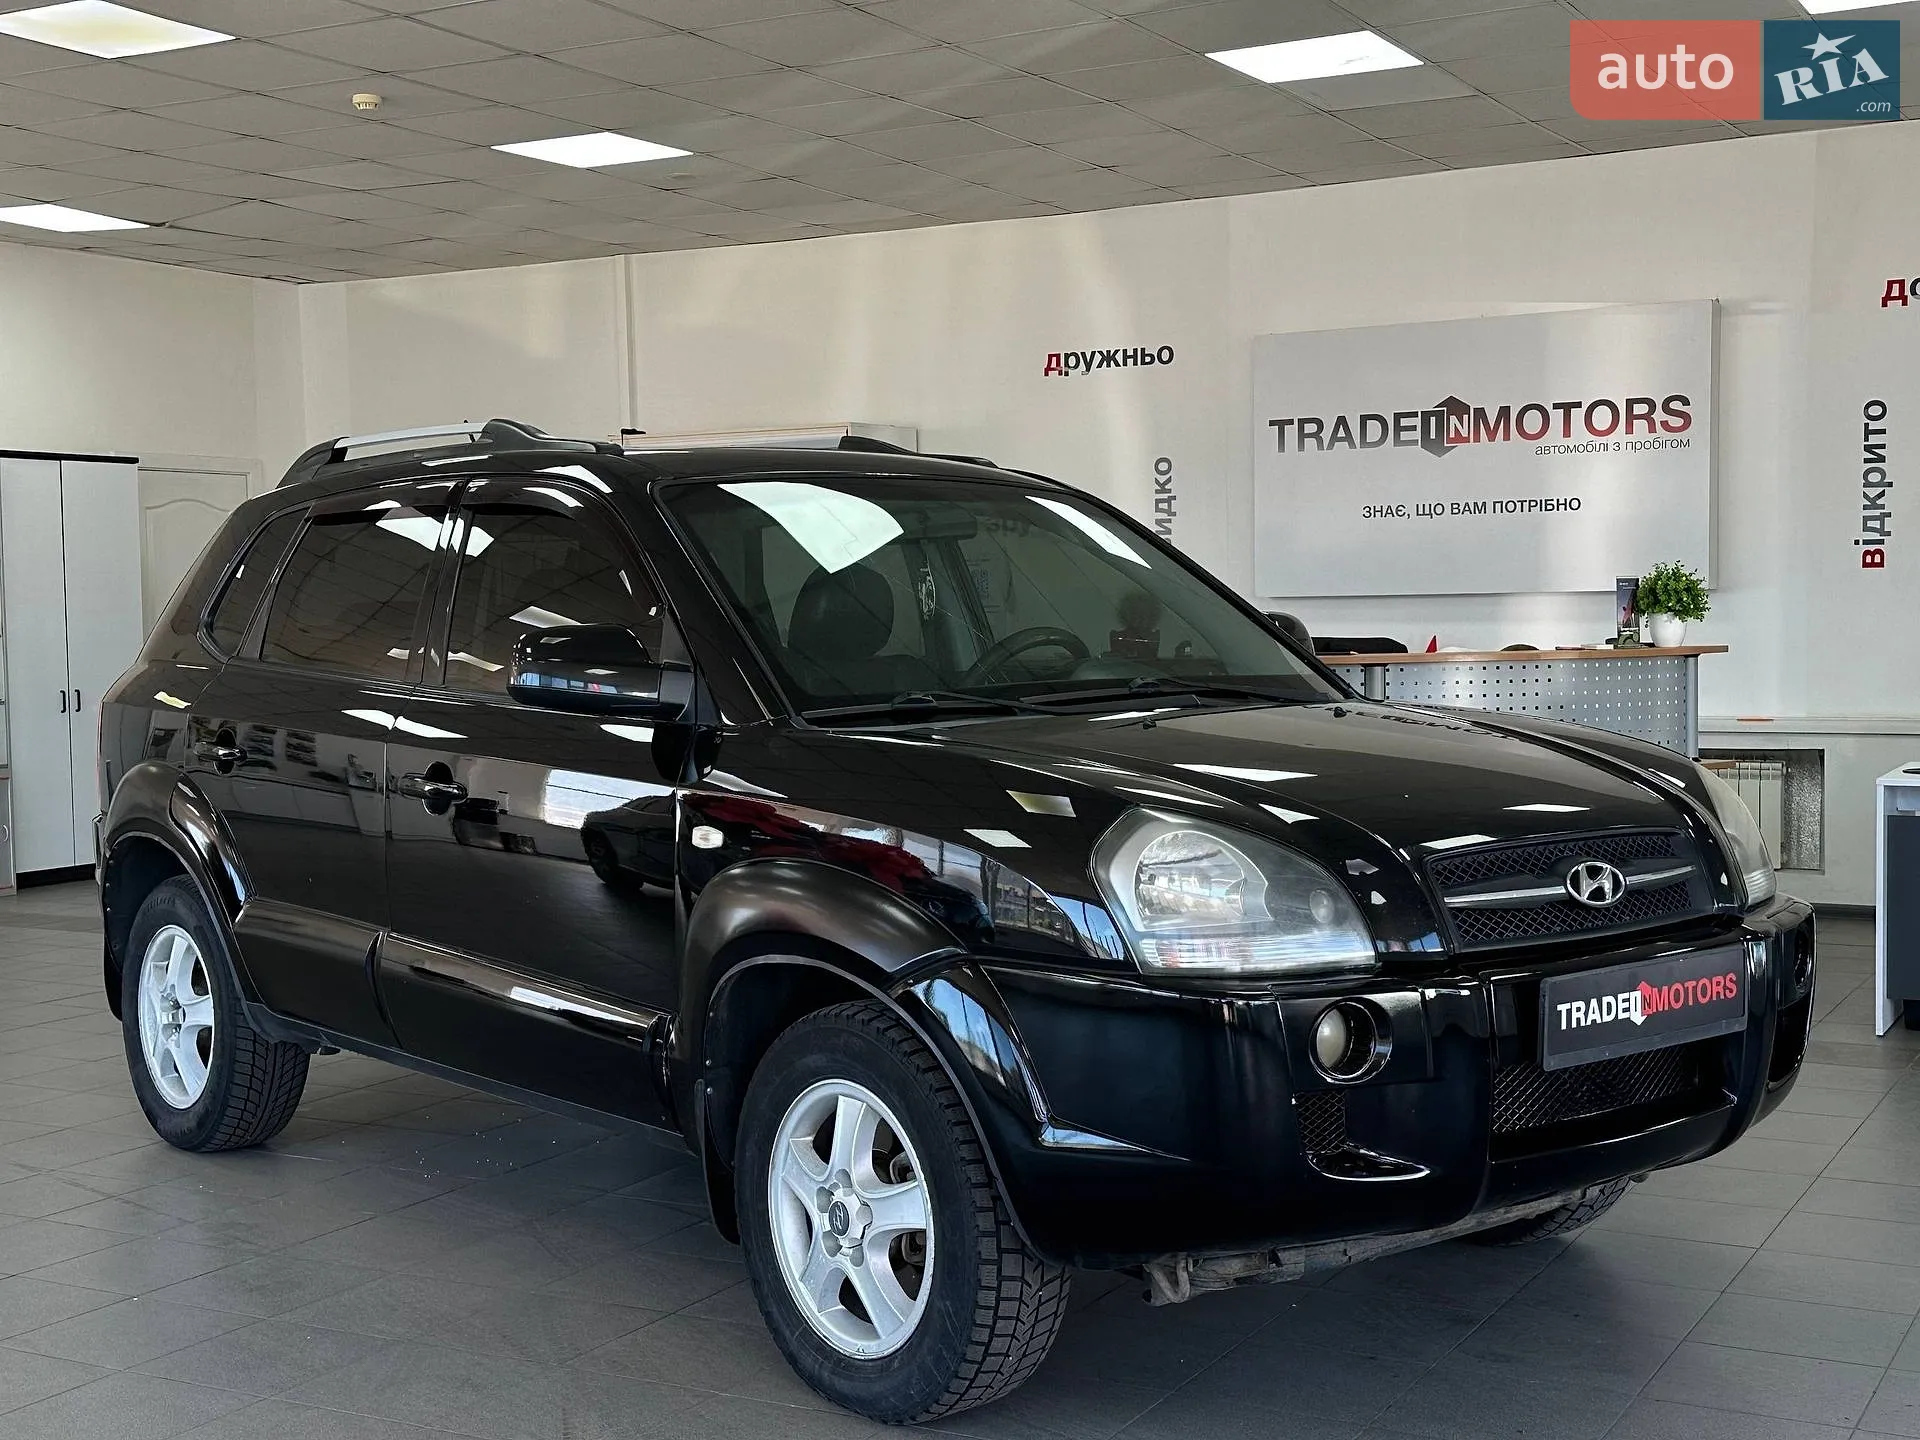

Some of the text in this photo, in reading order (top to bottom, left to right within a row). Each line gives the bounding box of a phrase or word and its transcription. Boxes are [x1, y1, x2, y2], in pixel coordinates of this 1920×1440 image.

[1043, 345, 1175, 377] дружньо
[1535, 437, 1691, 456] автомобілі з пробігом
[1853, 399, 1893, 569] Відкрито
[1154, 457, 1177, 544] идко
[1362, 497, 1582, 519] ЗНАЄ, ЩО ВАМ ПОТРІБНО
